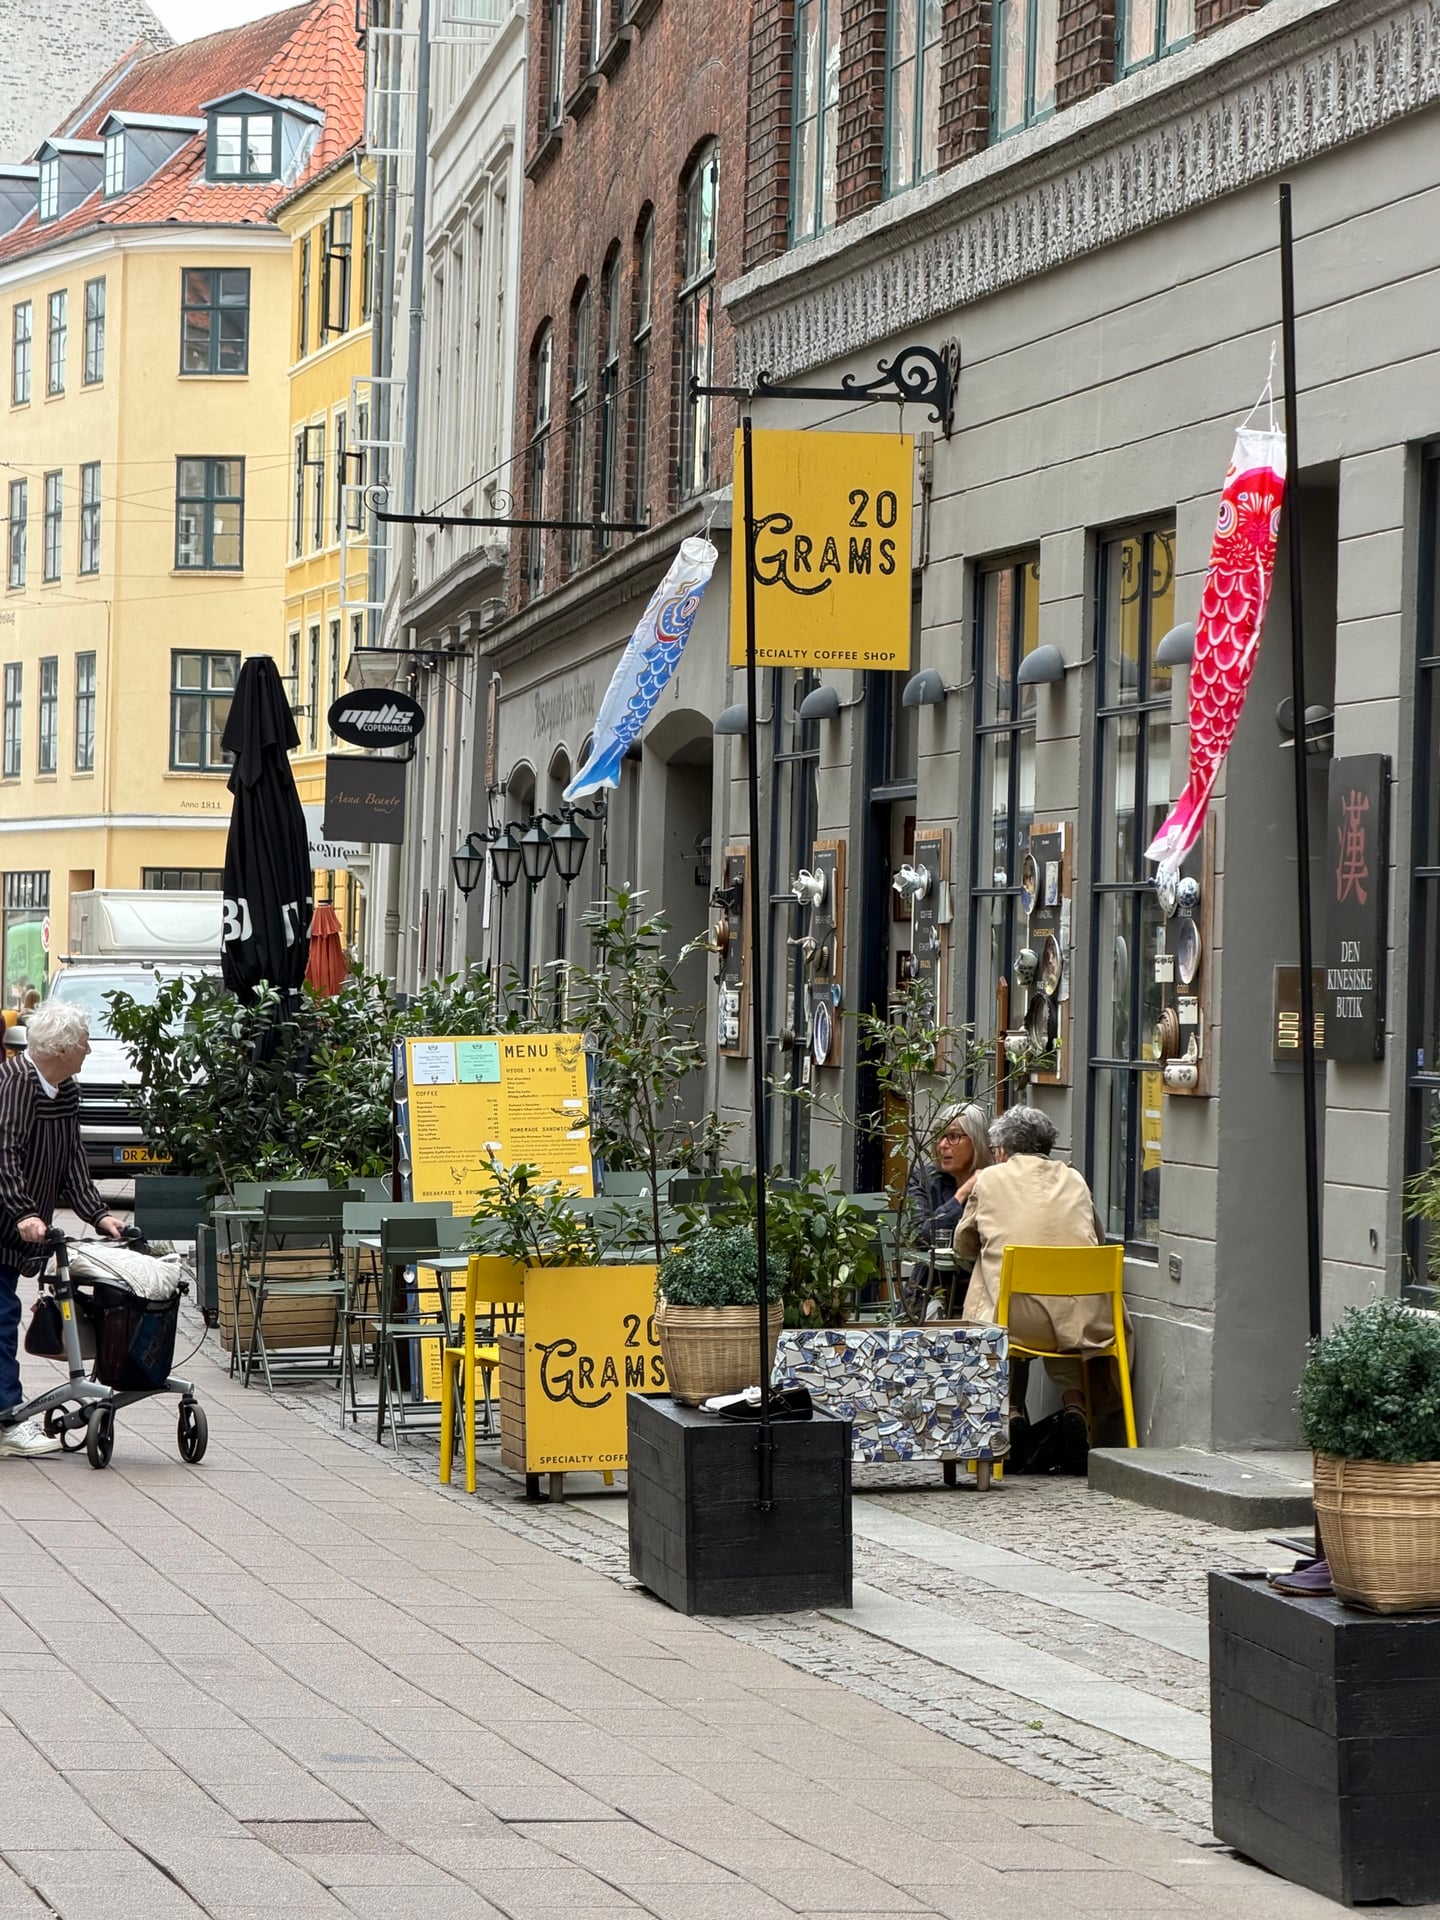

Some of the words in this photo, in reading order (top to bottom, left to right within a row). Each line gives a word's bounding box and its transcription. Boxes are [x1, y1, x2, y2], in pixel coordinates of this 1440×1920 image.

[848, 489, 898, 529] 20
[744, 512, 896, 596] GRAMS
[745, 648, 808, 659] PECIALTY
[813, 650, 858, 660] COFFEE
[863, 651, 897, 661] SHOP
[362, 723, 414, 733] COPENHAGEN
[180, 800, 200, 809] Anno
[200, 800, 222, 810] 1811
[329, 791, 361, 805] Anna
[364, 792, 401, 813] Beauty
[1341, 941, 1361, 963] DEN
[1326, 968, 1373, 991] KINESISKE
[1335, 996, 1364, 1018] BUTIK
[504, 1044, 549, 1059] MENU
[123, 1150, 138, 1161] DR
[534, 1338, 666, 1408] GRAMS
[539, 1455, 594, 1465] SPECIALTY
[598, 1453, 629, 1463] COFF
